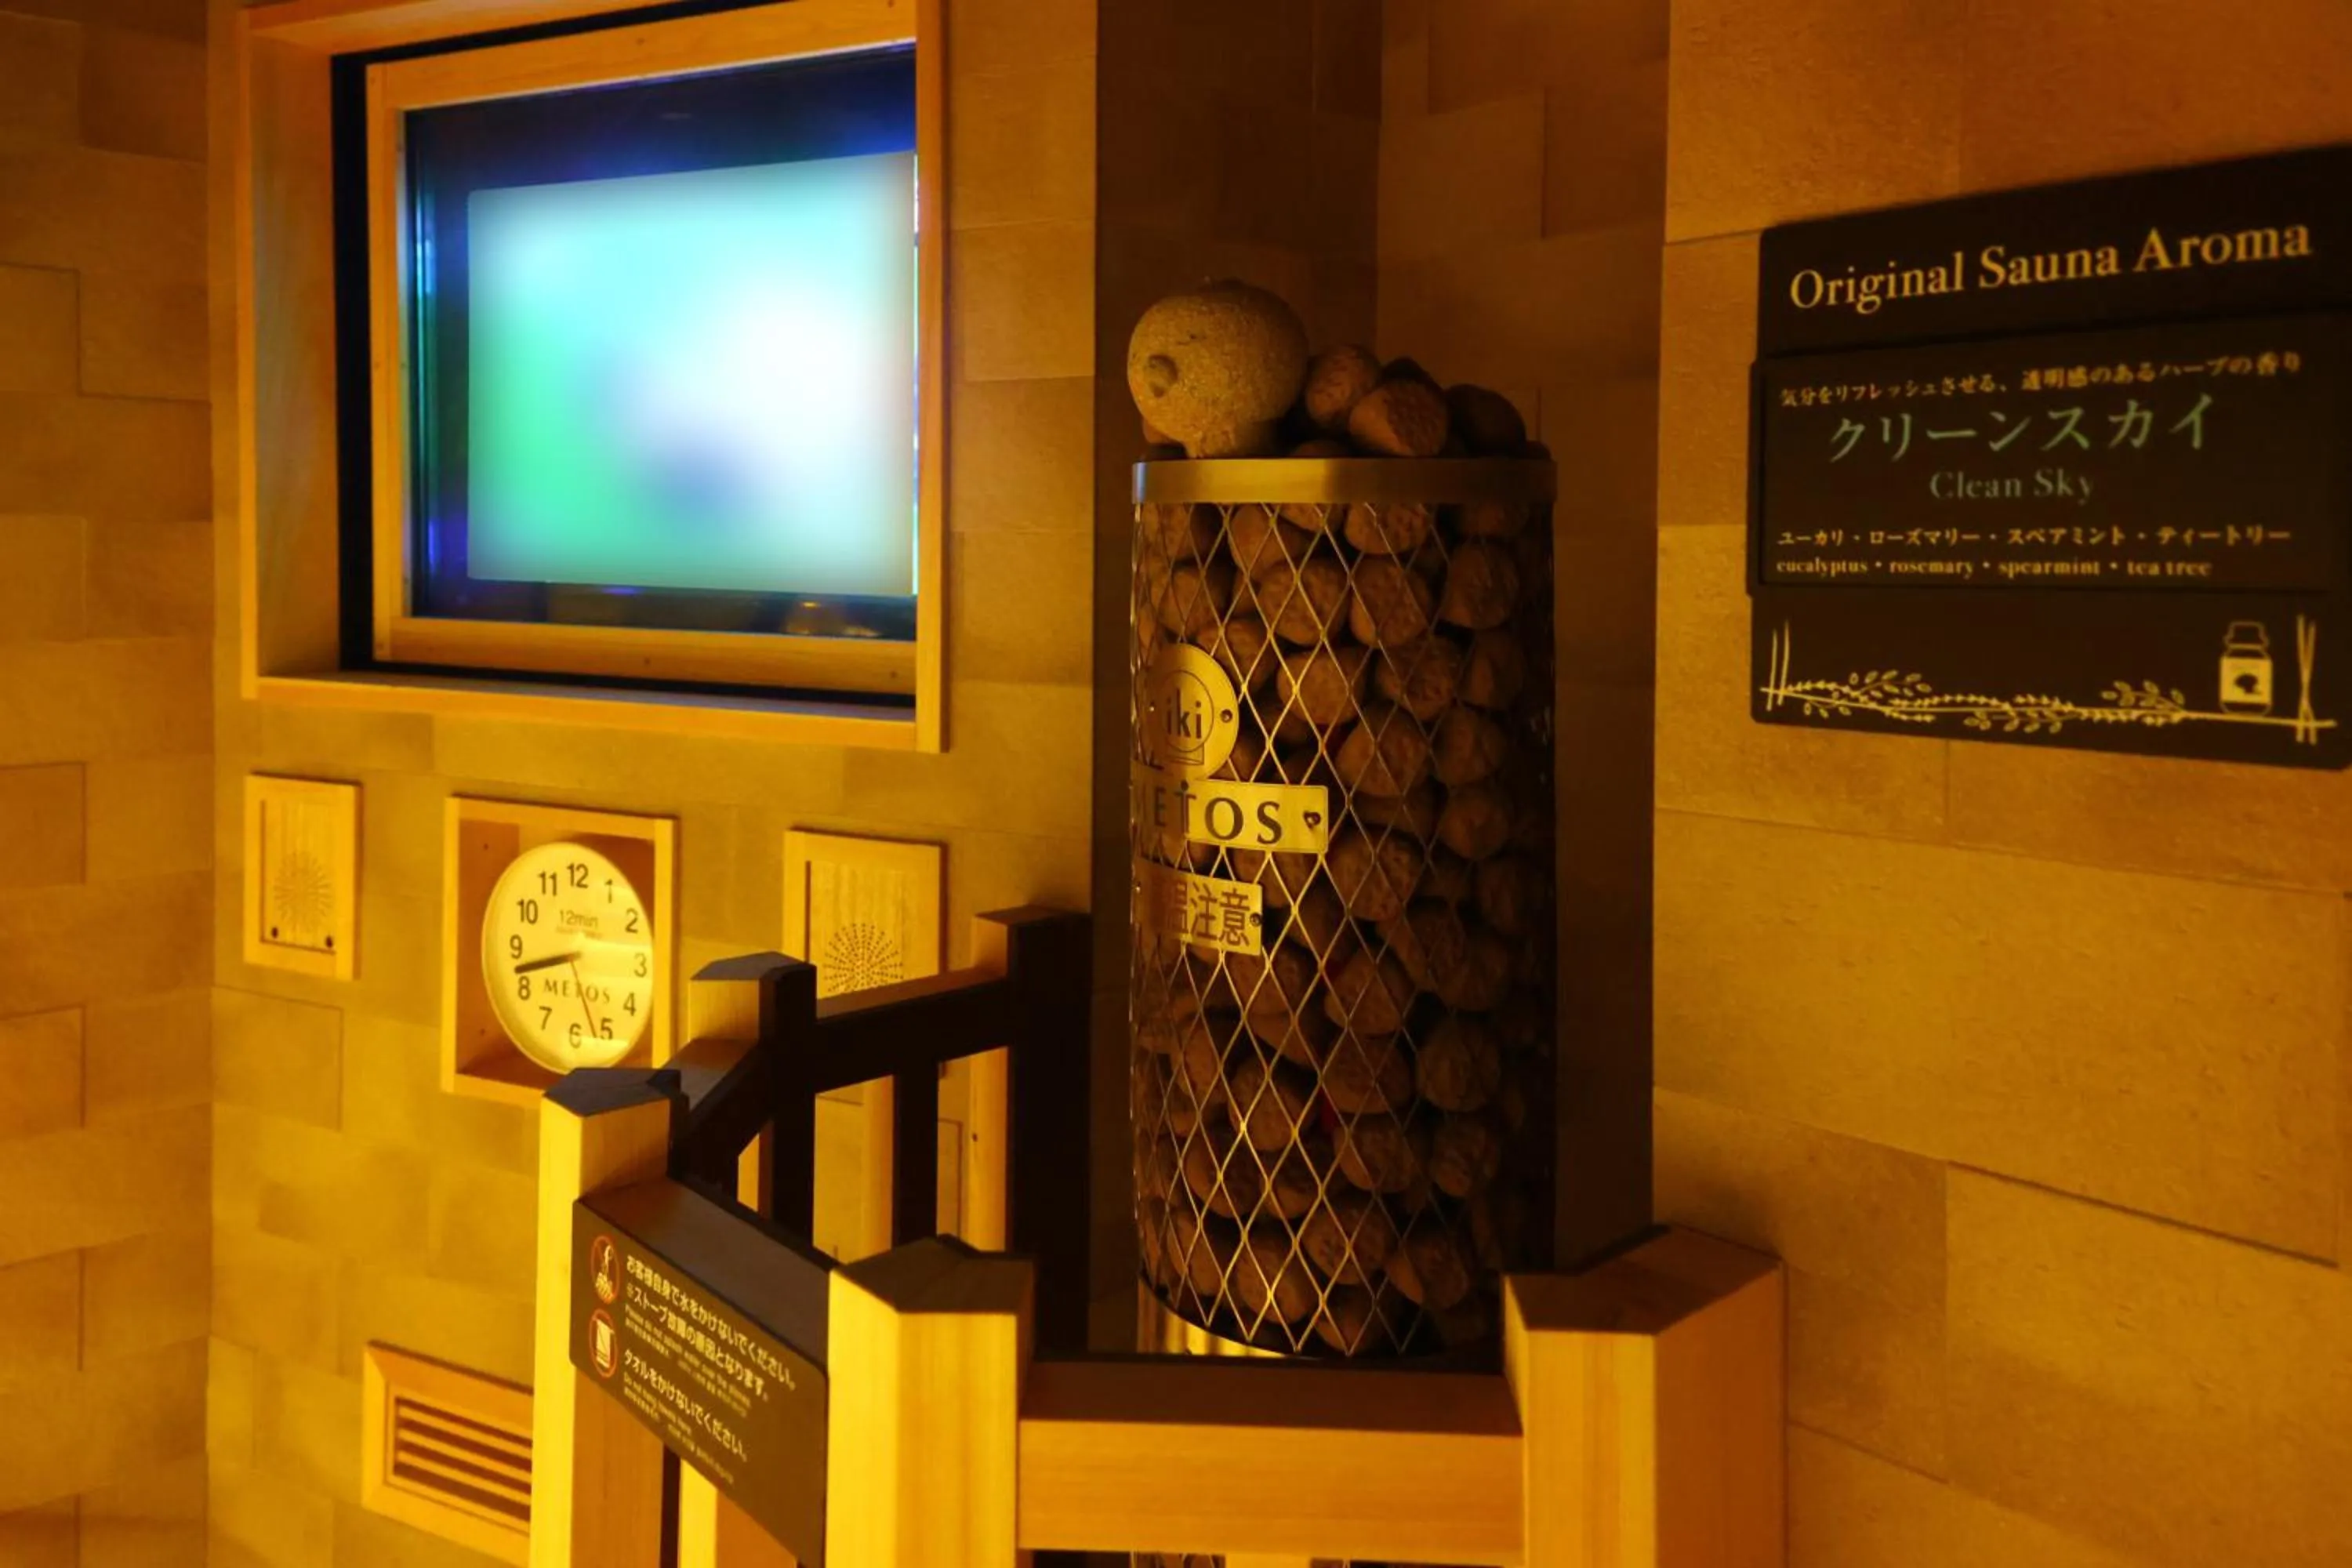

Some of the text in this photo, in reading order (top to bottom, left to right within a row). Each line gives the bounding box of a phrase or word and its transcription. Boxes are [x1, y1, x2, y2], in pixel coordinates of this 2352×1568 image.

[1790, 224, 2311, 314] Original Sauna Aroma
[1830, 393, 2214, 463] クリーンスカイ
[1929, 469, 2095, 504] Clean Sky
[1777, 557, 2212, 579] eucalyptus rosemary spearmint tea tree
[1166, 688, 1203, 739] iki
[538, 871, 557, 896] 11
[566, 863, 589, 888] 12
[604, 878, 614, 903] 1
[516, 898, 539, 924] 10
[625, 908, 638, 935] 2
[1154, 878, 1250, 947] 温注意
[510, 935, 523, 959] 9
[633, 953, 648, 978] 3
[517, 975, 532, 1000] 8
[543, 978, 611, 1005] METOS
[623, 993, 637, 1017] 4
[539, 1006, 552, 1031] 7
[600, 1018, 614, 1041] 5
[568, 1022, 582, 1048] 6
